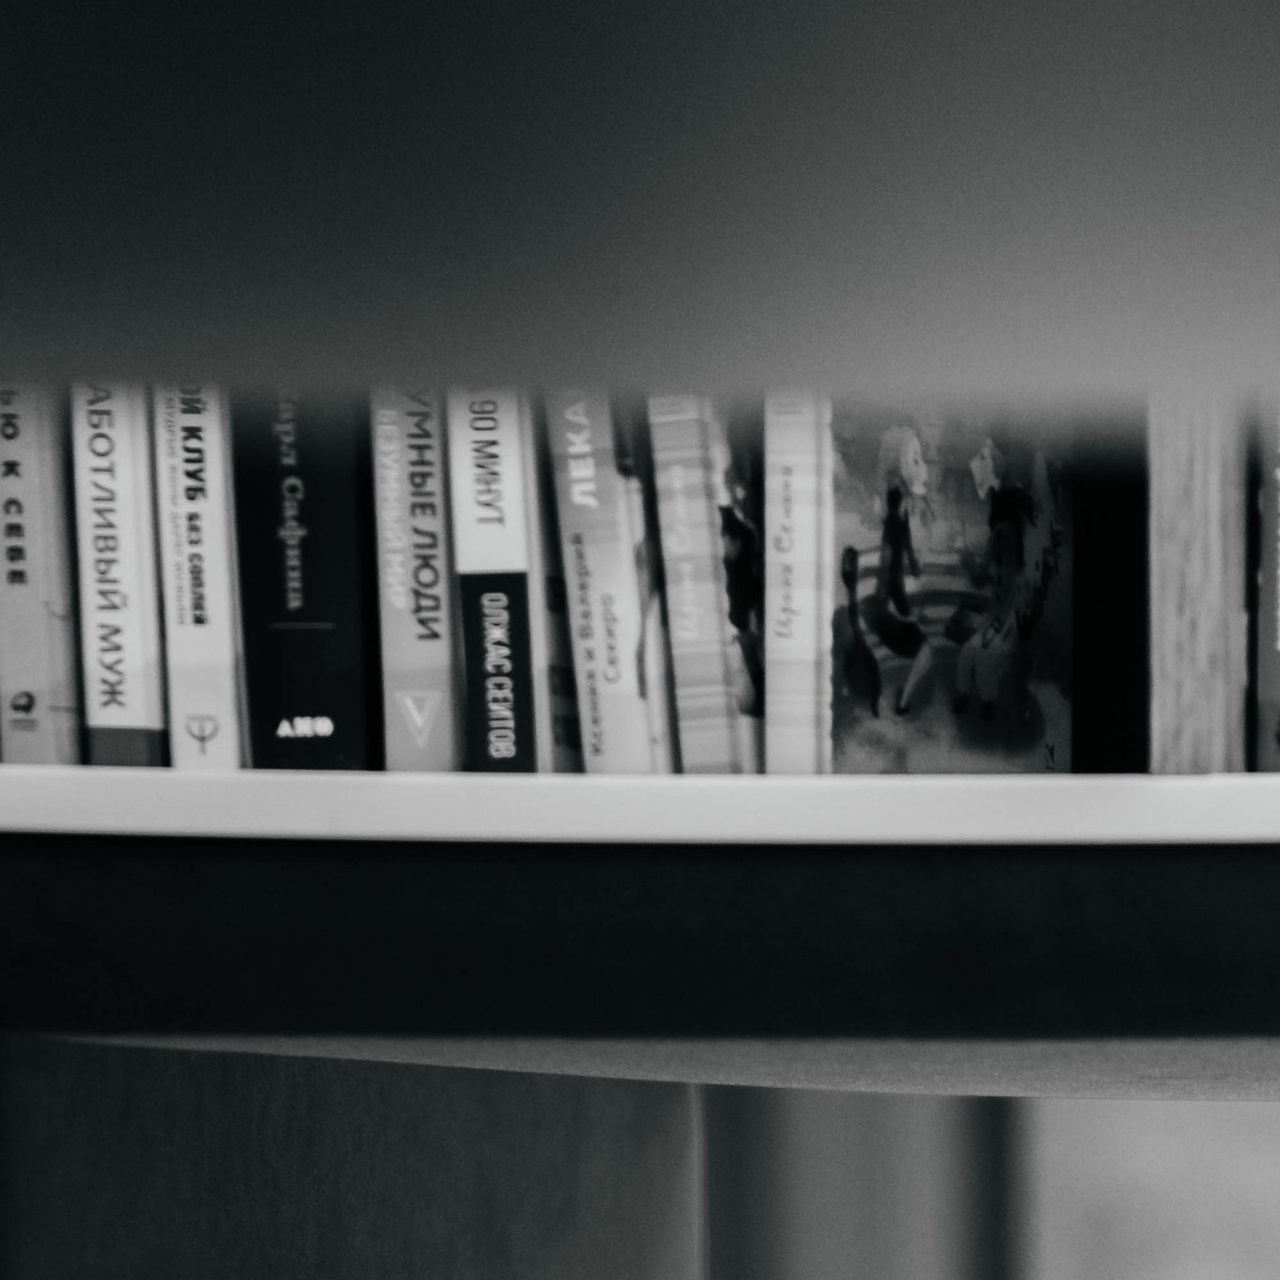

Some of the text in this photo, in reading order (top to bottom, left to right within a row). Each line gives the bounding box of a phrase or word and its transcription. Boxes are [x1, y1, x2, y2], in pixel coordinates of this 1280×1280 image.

[2, 461, 21, 478] К
[181, 426, 207, 501] КЛУБ
[469, 400, 506, 526] 90 МИНУТ
[564, 401, 598, 508] ЛЕКА
[3, 498, 27, 587] СЕБЕ
[278, 475, 307, 611] Сафина
[411, 527, 442, 641] ЛЮДИ
[99, 623, 126, 709] МУЖ
[481, 592, 512, 673] ОЛЖАС
